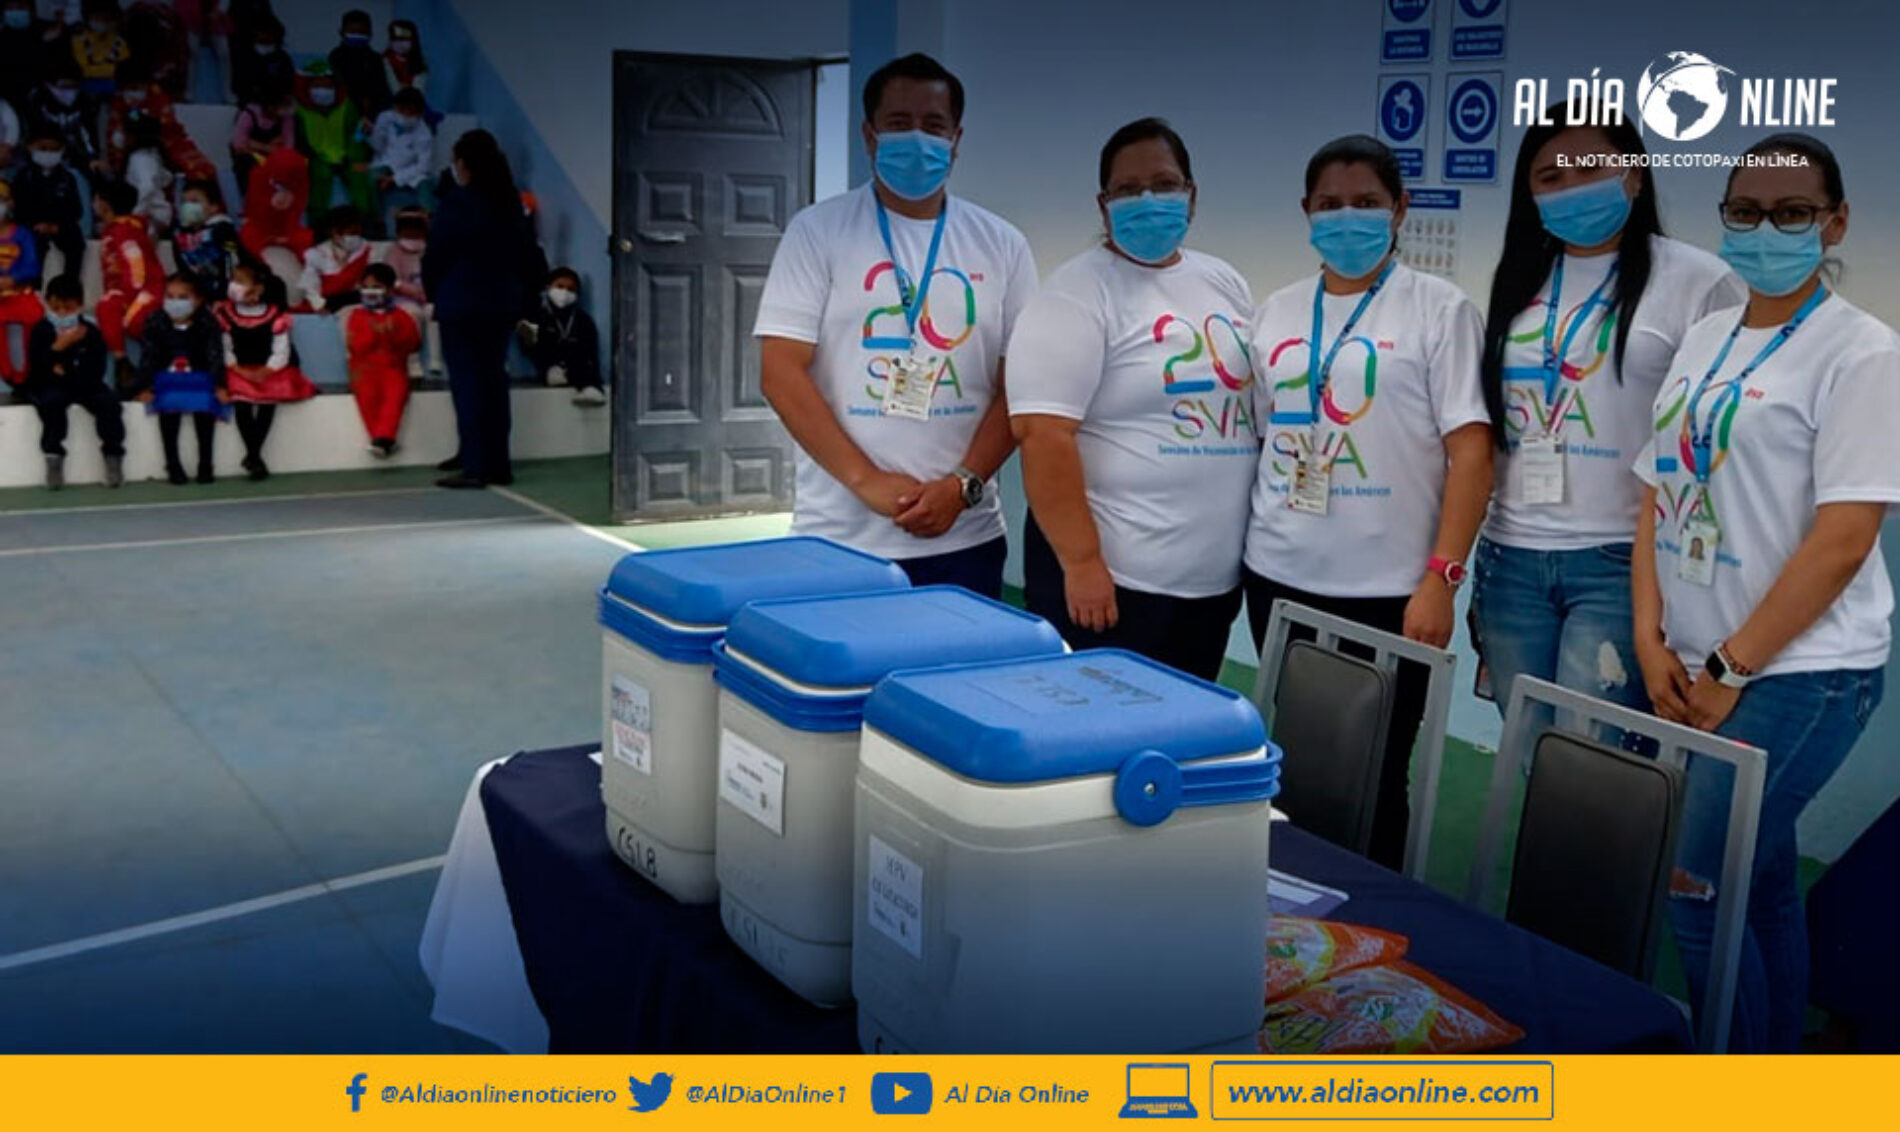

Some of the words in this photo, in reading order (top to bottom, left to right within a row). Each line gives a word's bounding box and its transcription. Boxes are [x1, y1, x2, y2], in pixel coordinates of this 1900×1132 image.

[1152, 313, 1255, 394] 20
[1268, 335, 1378, 426] 20
[1171, 395, 1256, 440] SVA
